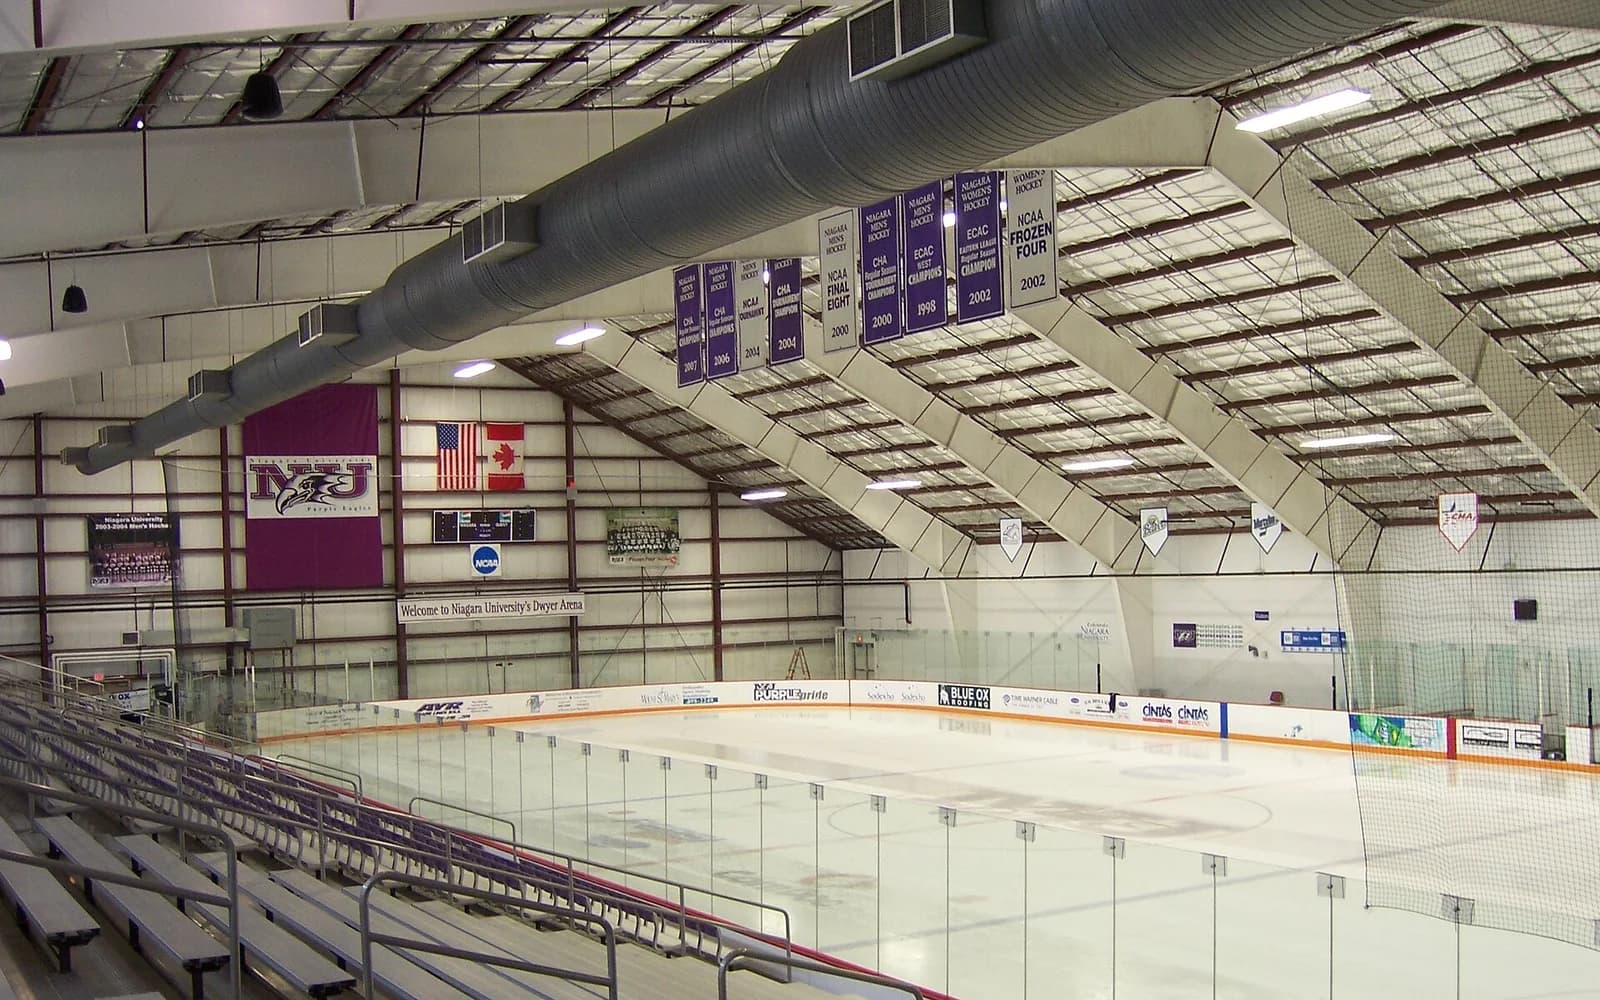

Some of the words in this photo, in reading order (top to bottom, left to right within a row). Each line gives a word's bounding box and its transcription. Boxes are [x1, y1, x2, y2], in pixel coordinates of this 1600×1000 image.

[962, 175, 991, 192] NIAGARA
[1013, 168, 1046, 184] WOMEN'S
[961, 185, 992, 202] WOMEN'S
[1016, 177, 1044, 195] HOCKEY
[908, 192, 936, 208] NIAGARA
[963, 196, 991, 212] HOCKEY
[866, 208, 892, 223] NIAGARA
[914, 204, 932, 216] MEN'S
[910, 213, 935, 228] HOCKEY
[1018, 209, 1044, 227] NCAA
[824, 223, 848, 237] NIAGARA
[870, 220, 888, 232] MEN'S
[966, 224, 989, 240] ECAC
[828, 234, 844, 245] MEN'S
[868, 229, 890, 242] HOCKEY
[1010, 222, 1052, 246] FROZEN
[826, 244, 846, 255] HOCKEY
[914, 245, 934, 260] ECAC
[1016, 240, 1046, 260] FOUR
[872, 256, 888, 268] CHA
[917, 258, 932, 270] WEST
[961, 257, 996, 277] CHAMPION
[828, 268, 848, 282] NCAA
[908, 266, 942, 286] CHAMPIONS
[1021, 274, 1046, 291] 2002
[777, 283, 790, 296] CHA
[828, 281, 850, 297] FINAL
[868, 286, 895, 301] CHAMPIONS
[968, 288, 992, 305] 2002
[828, 294, 850, 311] EIGHT
[918, 300, 936, 316] 1998
[872, 313, 892, 328] 2000
[832, 324, 849, 338] 2000
[778, 336, 796, 350] 2004
[684, 360, 698, 373] 2007
[714, 353, 730, 366] 2006
[250, 464, 372, 500] NU
[476, 560, 498, 568] NCAA
[401, 605, 438, 617] Welcome
[440, 604, 449, 615] to
[452, 603, 482, 617] Niagara
[484, 600, 531, 614] University's
[533, 600, 558, 612] Dwyer
[560, 598, 583, 610] Arena
[754, 689, 802, 700] PURPLE
[800, 690, 828, 700] pride
[951, 687, 974, 700] BLUE
[976, 689, 989, 700] OX
[1025, 696, 1042, 704] WARNER
[951, 700, 989, 708] ROOFING
